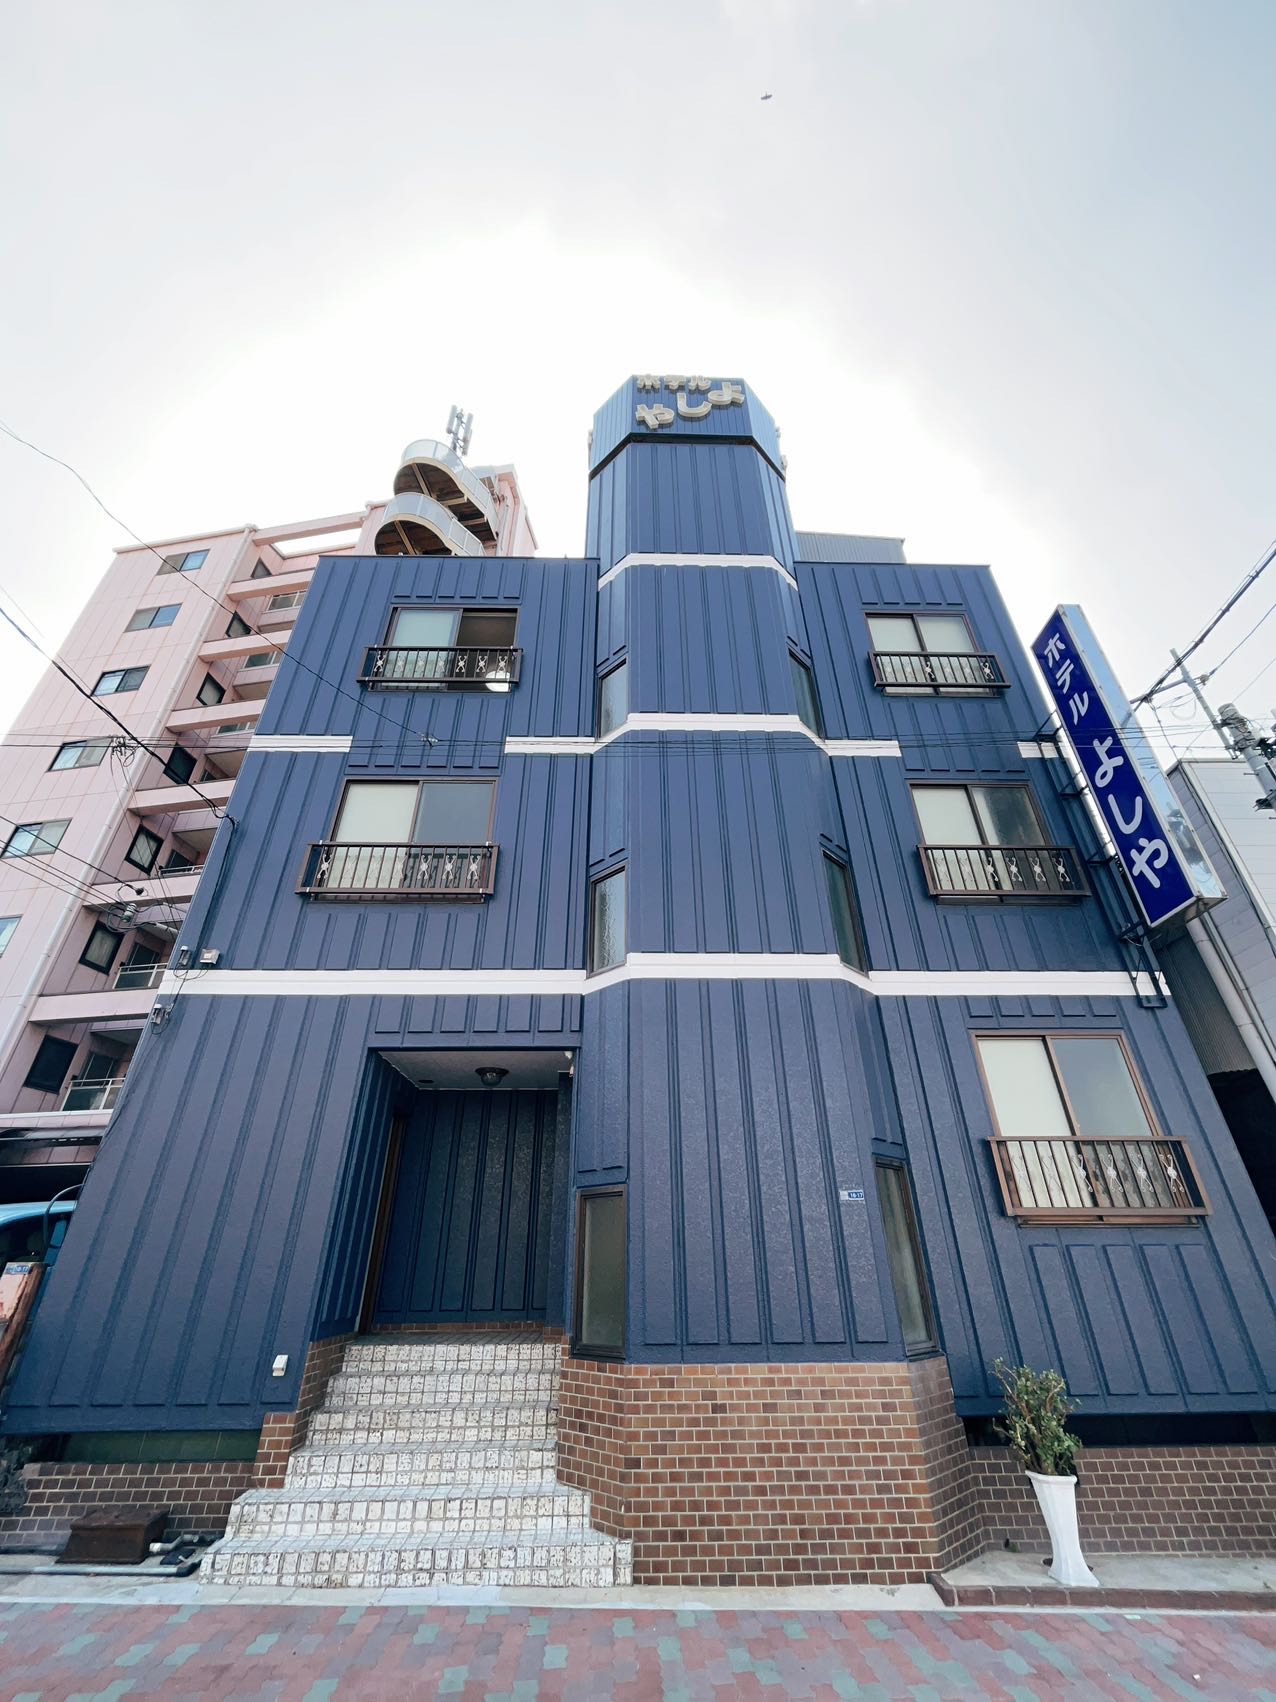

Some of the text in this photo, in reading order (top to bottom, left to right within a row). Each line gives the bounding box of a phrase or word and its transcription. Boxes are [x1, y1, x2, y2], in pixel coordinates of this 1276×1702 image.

[636, 373, 712, 391] ホテル
[1043, 632, 1169, 889] ホテル よしや
